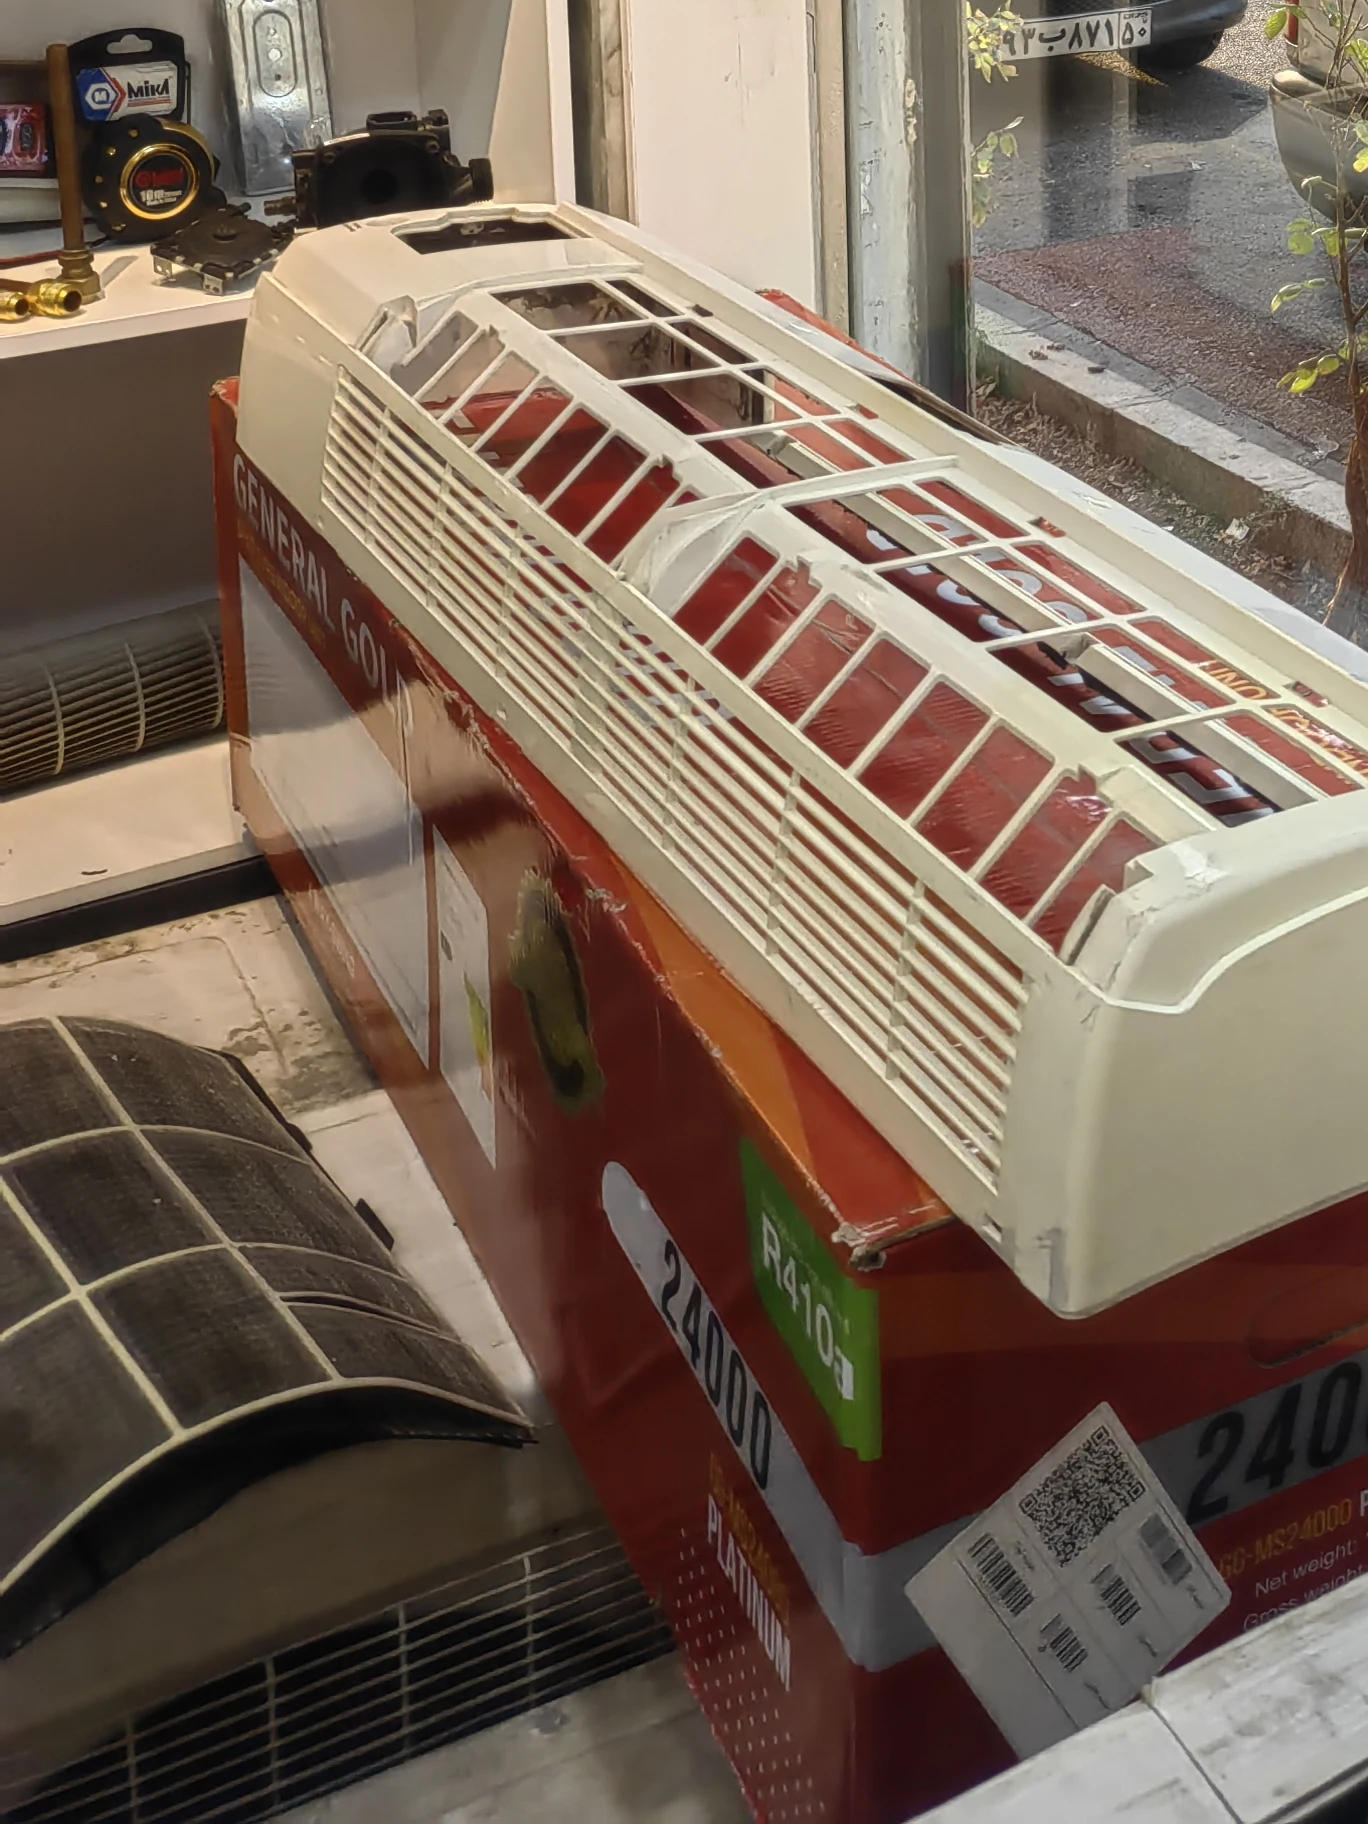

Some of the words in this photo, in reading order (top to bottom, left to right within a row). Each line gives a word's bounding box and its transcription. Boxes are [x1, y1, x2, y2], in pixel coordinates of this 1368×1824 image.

[233, 453, 336, 635] GENERAL
[341, 598, 414, 737] GOLD
[661, 1239, 772, 1491] 24000
[708, 1493, 790, 1692] PLATINUM
[1254, 1572, 1288, 1598] Net
[1293, 1537, 1358, 1580] weight:
